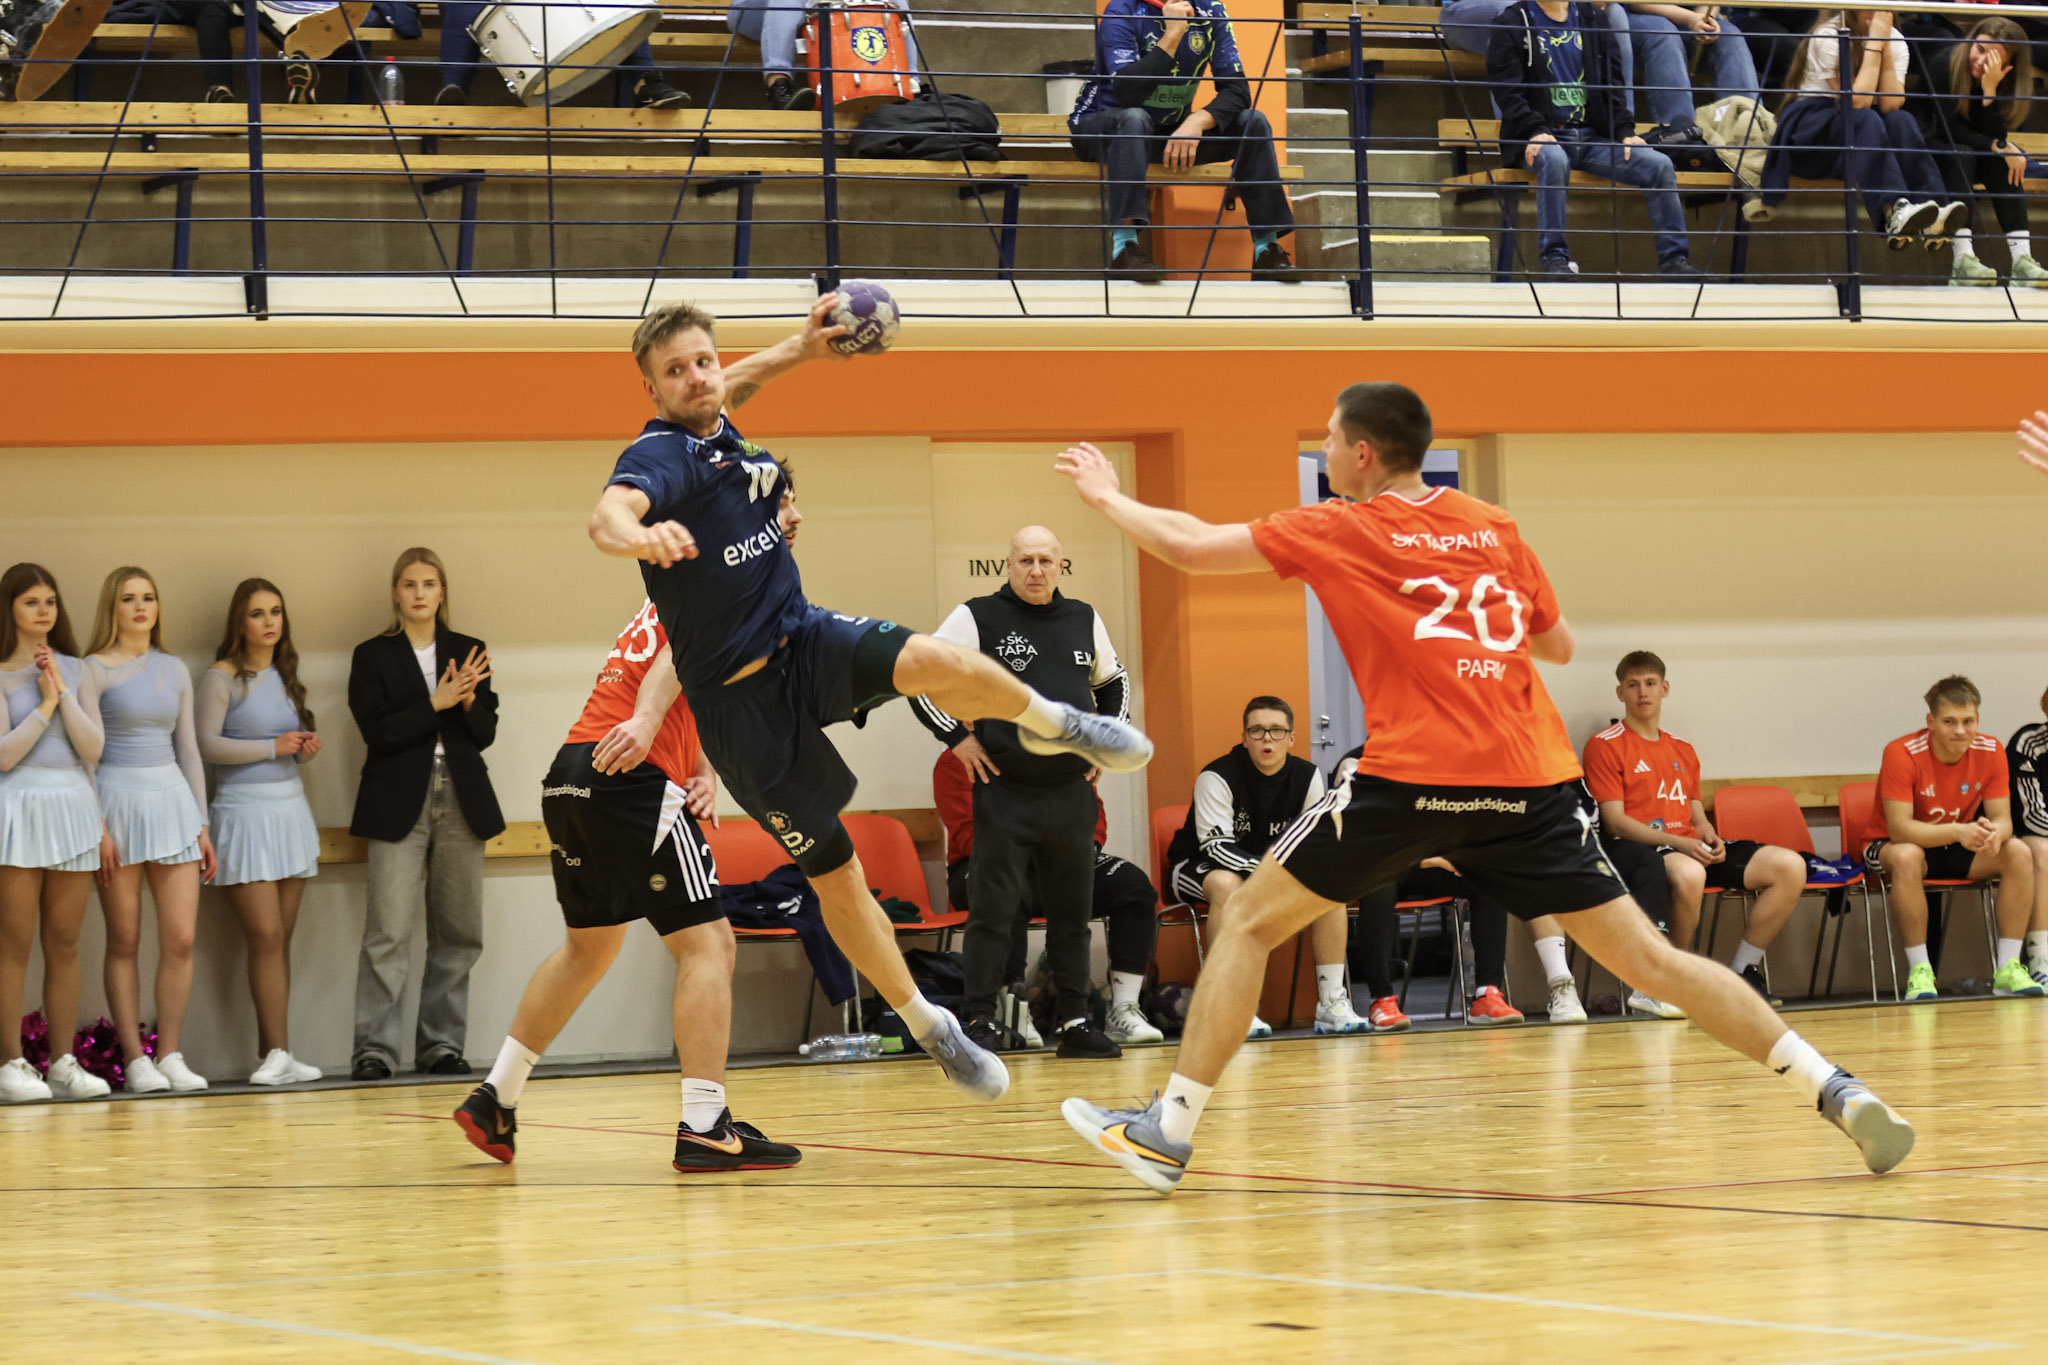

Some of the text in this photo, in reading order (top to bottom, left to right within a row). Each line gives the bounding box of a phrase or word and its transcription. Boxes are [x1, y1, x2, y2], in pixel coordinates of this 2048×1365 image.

[723, 516, 782, 566] excell
[1398, 574, 1524, 652] 20
[996, 644, 1038, 656] TAPA
[1006, 635, 1025, 645] SK
[1657, 778, 1687, 806] 44
